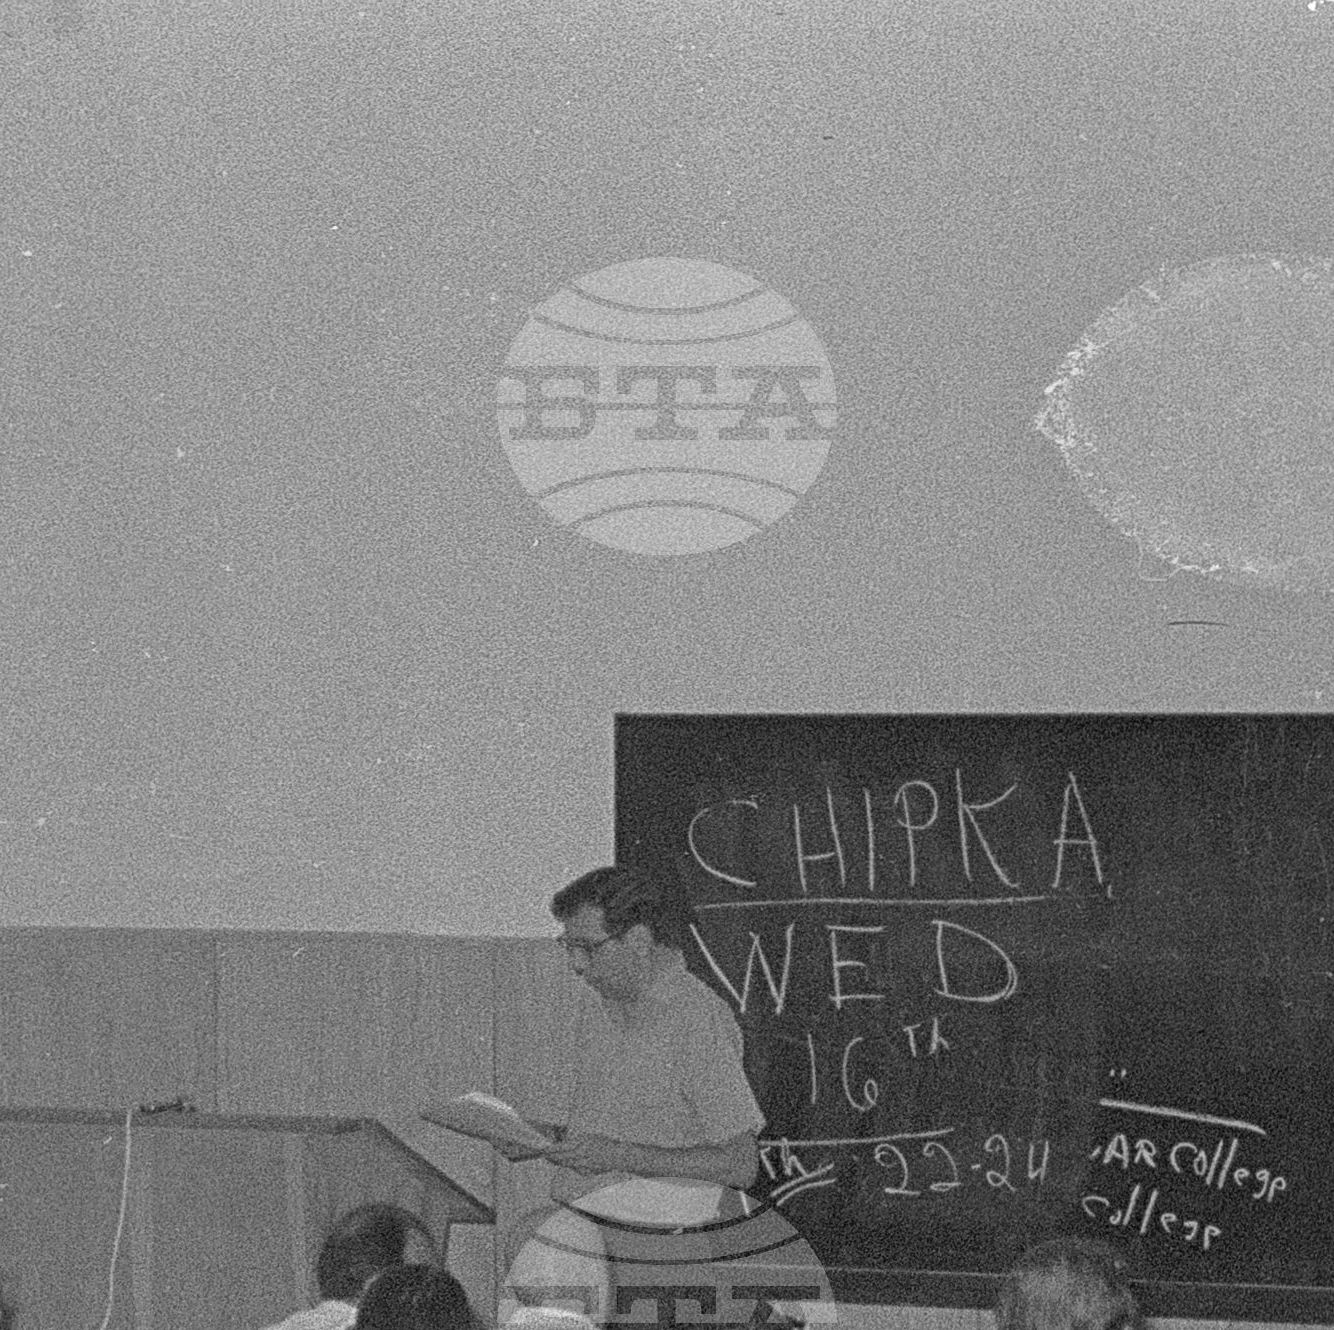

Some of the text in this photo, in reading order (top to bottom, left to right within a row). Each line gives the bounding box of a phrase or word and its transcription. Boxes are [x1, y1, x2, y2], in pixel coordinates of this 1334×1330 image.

[689, 768, 1104, 893] CHIPKA
[689, 919, 1019, 1014] WED
[807, 1033, 879, 1112] 16
[873, 1133, 1051, 1196] 22-24
